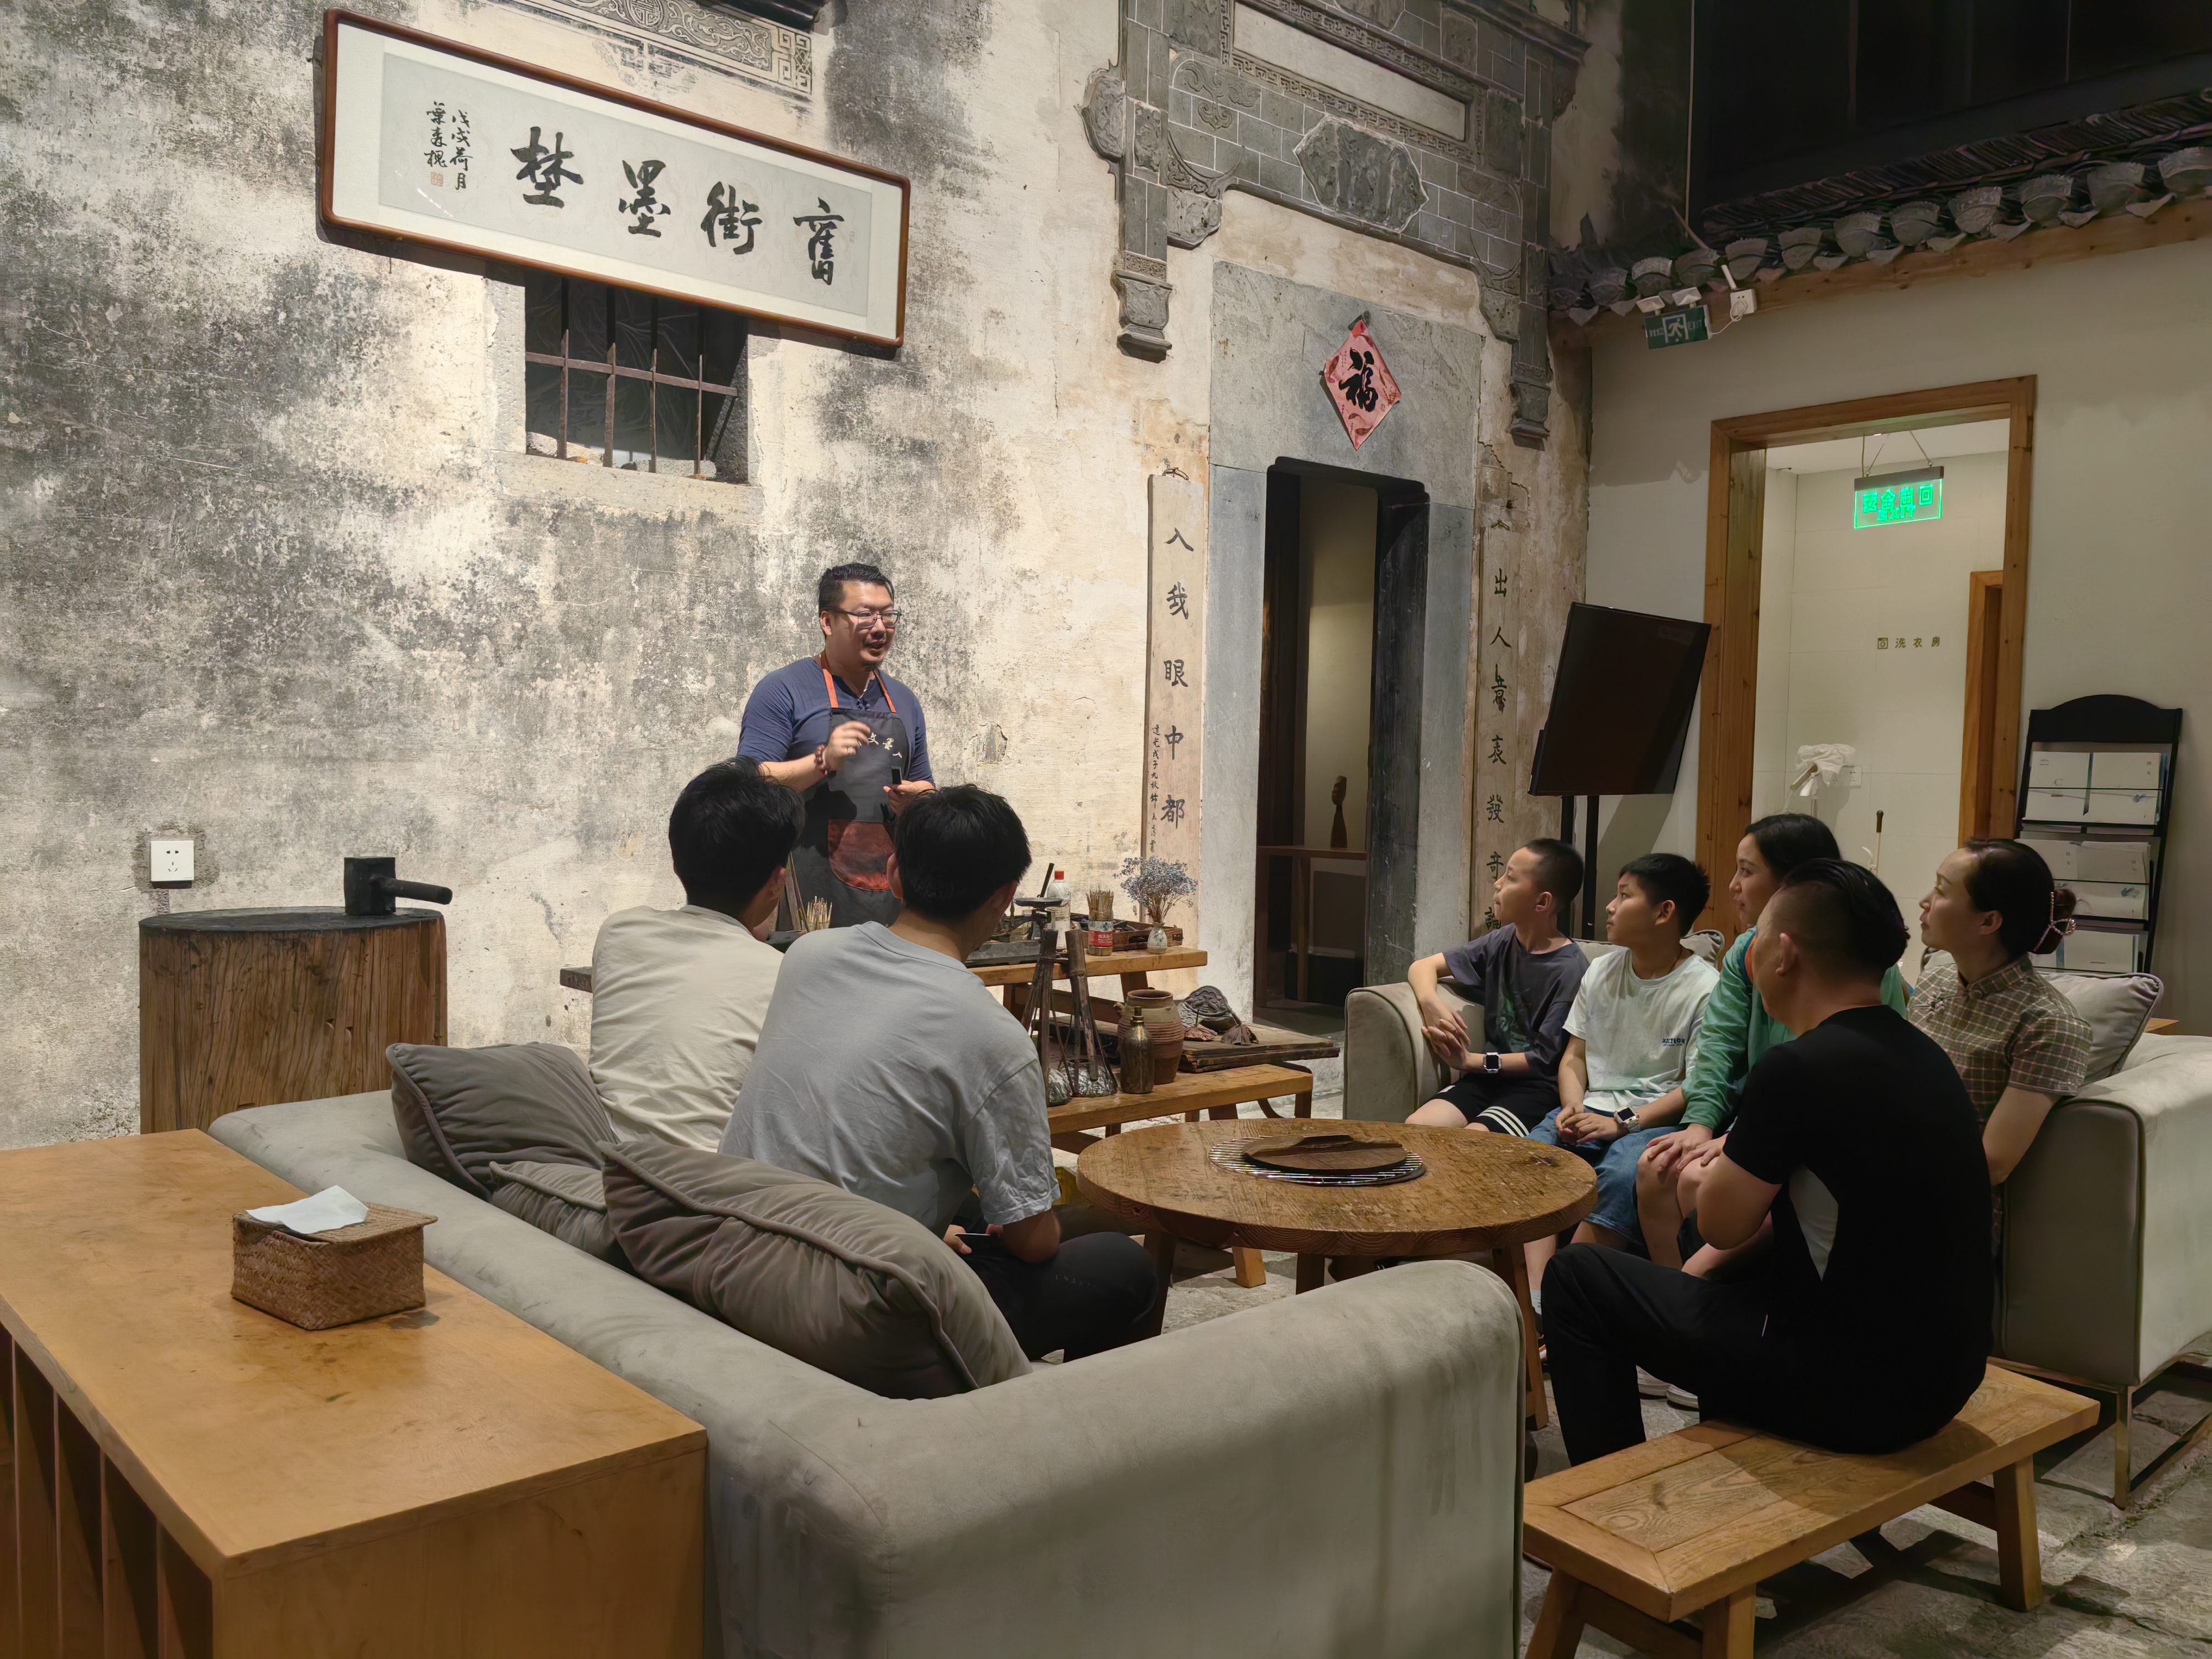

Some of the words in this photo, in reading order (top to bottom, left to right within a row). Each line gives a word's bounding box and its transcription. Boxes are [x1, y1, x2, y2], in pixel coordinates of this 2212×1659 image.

[1687, 319, 1702, 330] EXIT
[1338, 347, 1379, 413] 福
[1863, 484, 1933, 513] 安全出口
[1878, 505, 1917, 522] EXIT
[1895, 636, 1940, 649] 洗衣房
